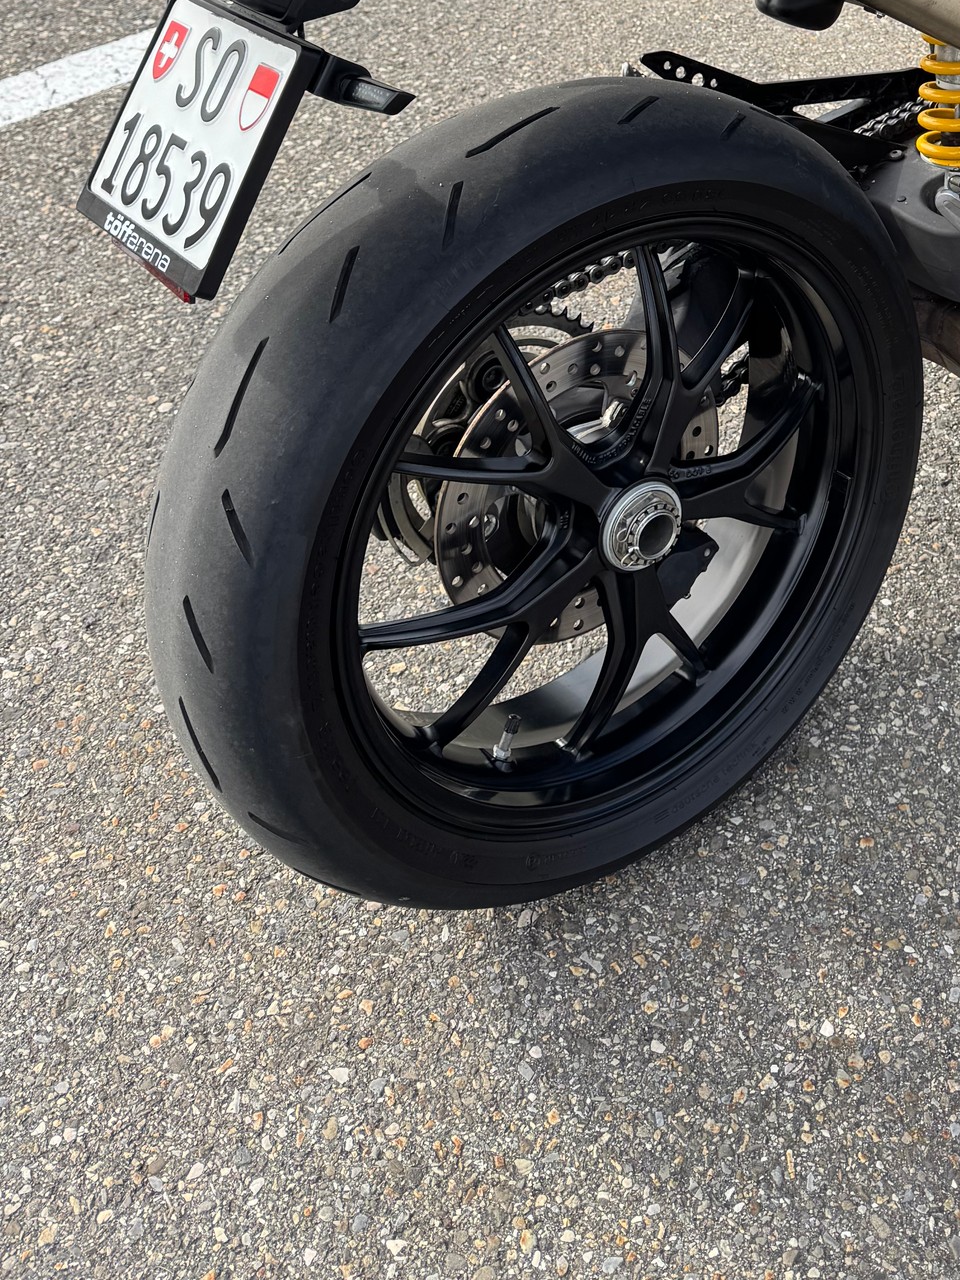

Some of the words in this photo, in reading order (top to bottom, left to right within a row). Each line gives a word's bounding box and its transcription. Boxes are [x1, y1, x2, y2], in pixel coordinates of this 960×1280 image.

[175, 26, 247, 123] SO
[100, 112, 232, 250] 18539
[103, 211, 171, 273] töffarena
